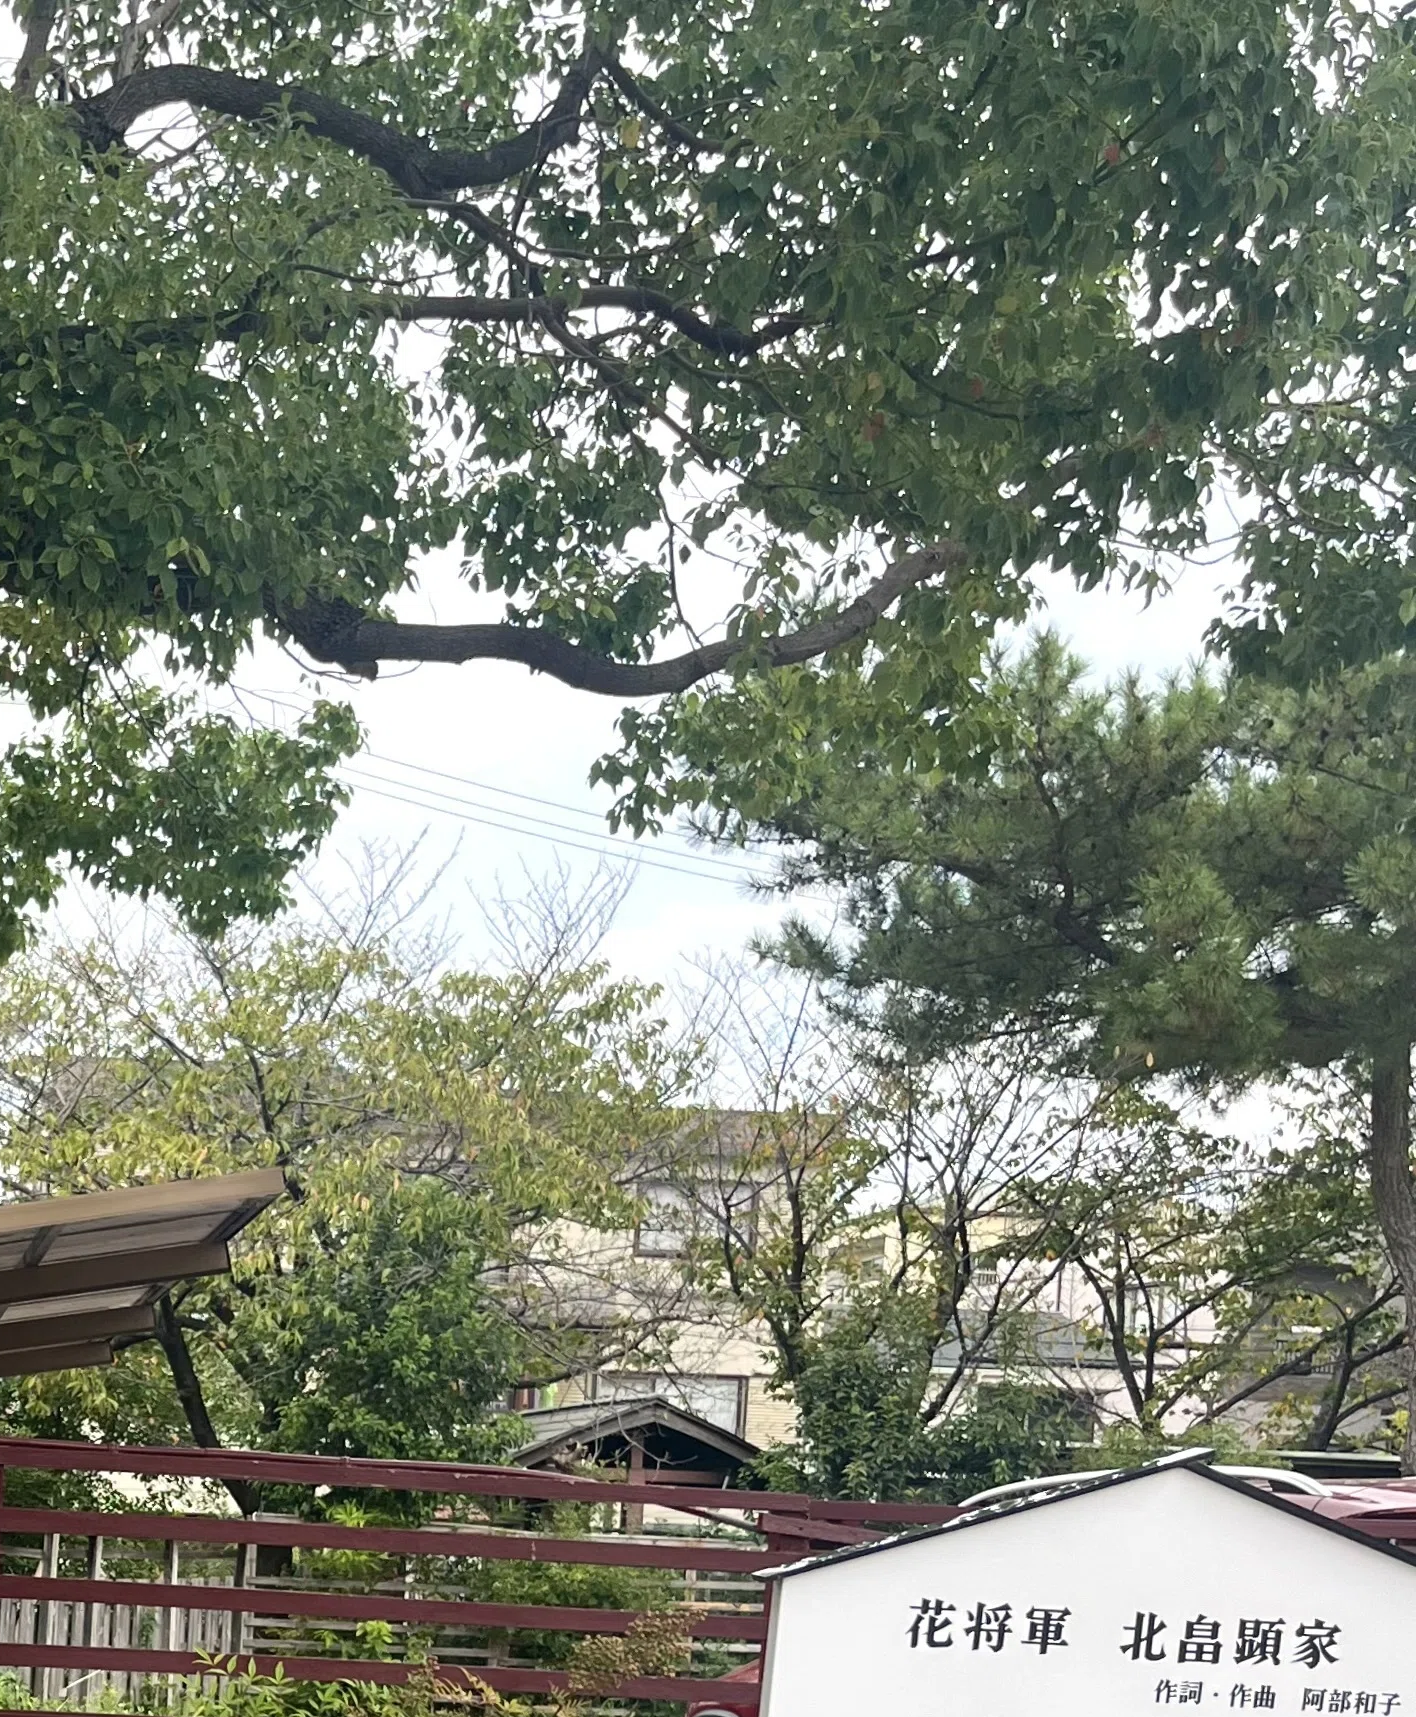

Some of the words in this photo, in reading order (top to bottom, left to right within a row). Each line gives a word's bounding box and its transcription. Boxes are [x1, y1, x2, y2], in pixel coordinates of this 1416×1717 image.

[905, 1597, 1072, 1656] 花将軍
[1119, 1611, 1342, 1669] 北畠顕家
[1301, 1686, 1402, 1717] 阿部和子
